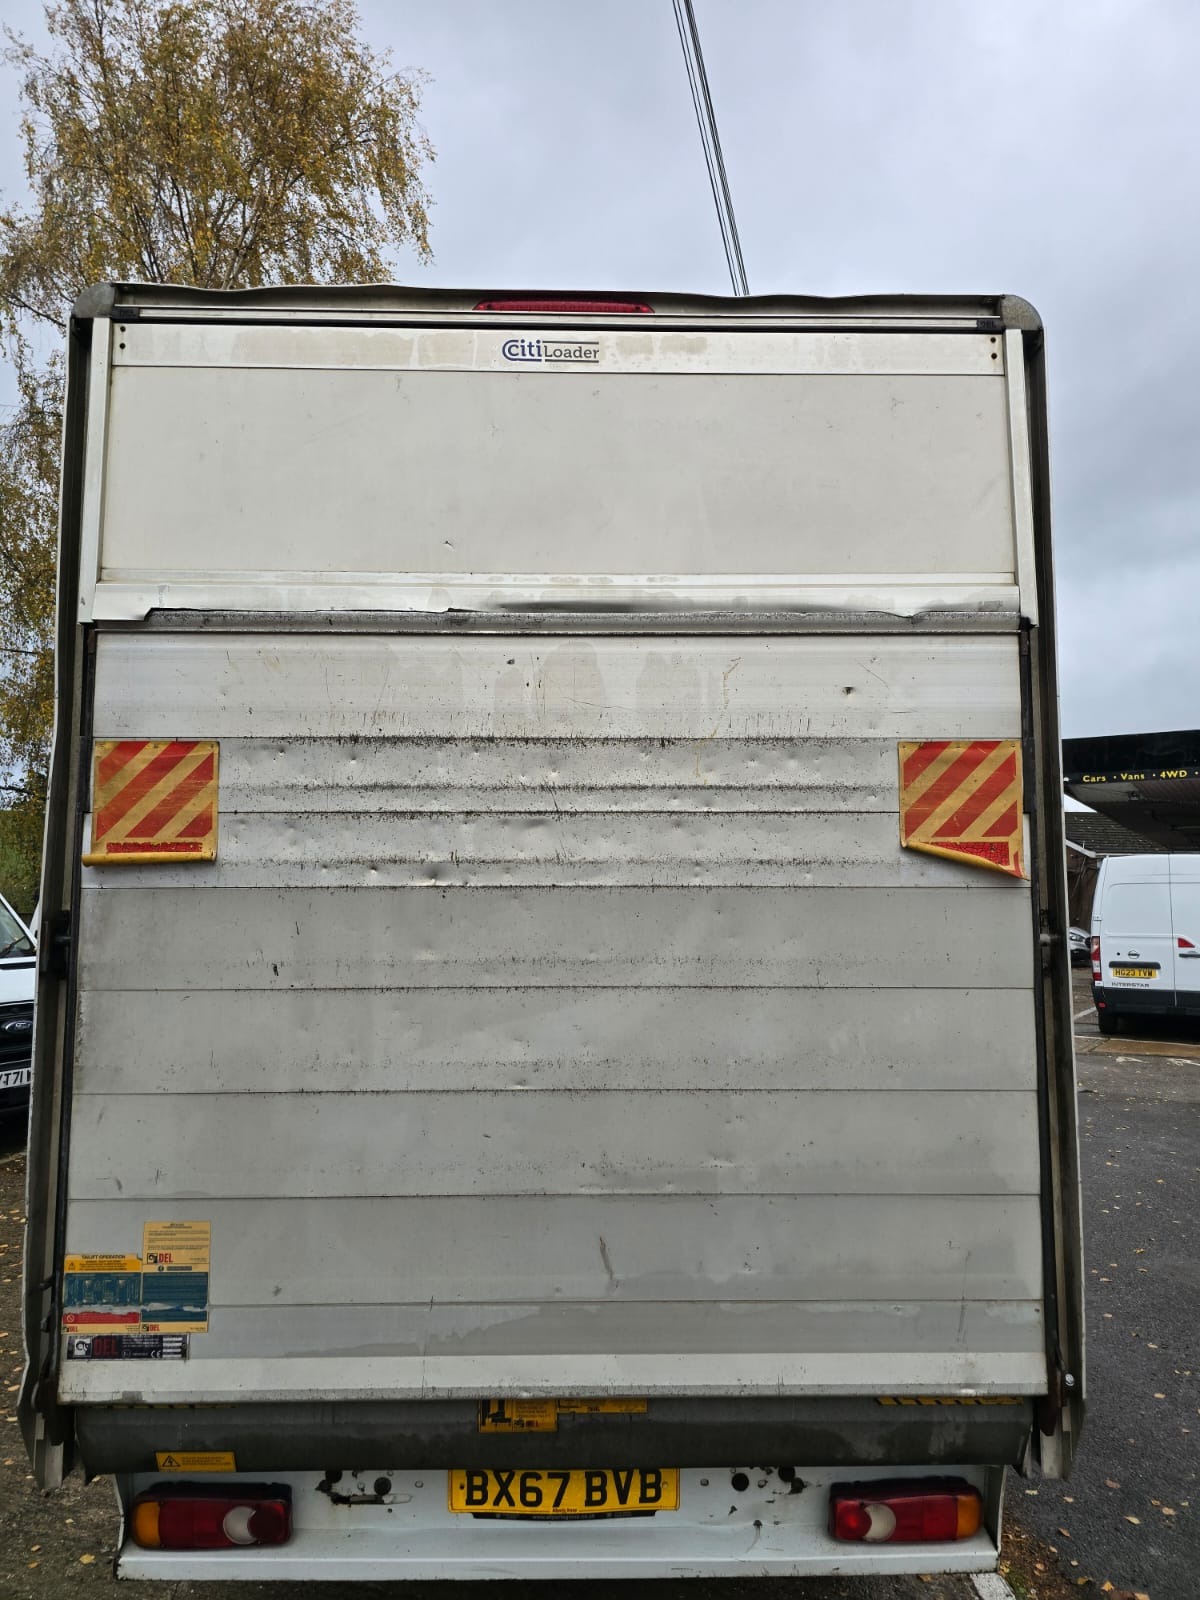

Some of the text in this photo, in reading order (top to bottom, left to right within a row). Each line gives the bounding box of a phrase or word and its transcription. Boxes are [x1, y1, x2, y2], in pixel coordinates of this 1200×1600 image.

[502, 338, 600, 362] Citi Loader
[1082, 770, 1188, 783] Cars Vans 4WD
[0, 1070, 23, 1085] T71
[158, 1253, 174, 1263] DEL
[465, 1469, 662, 1508] BX67 BVB
